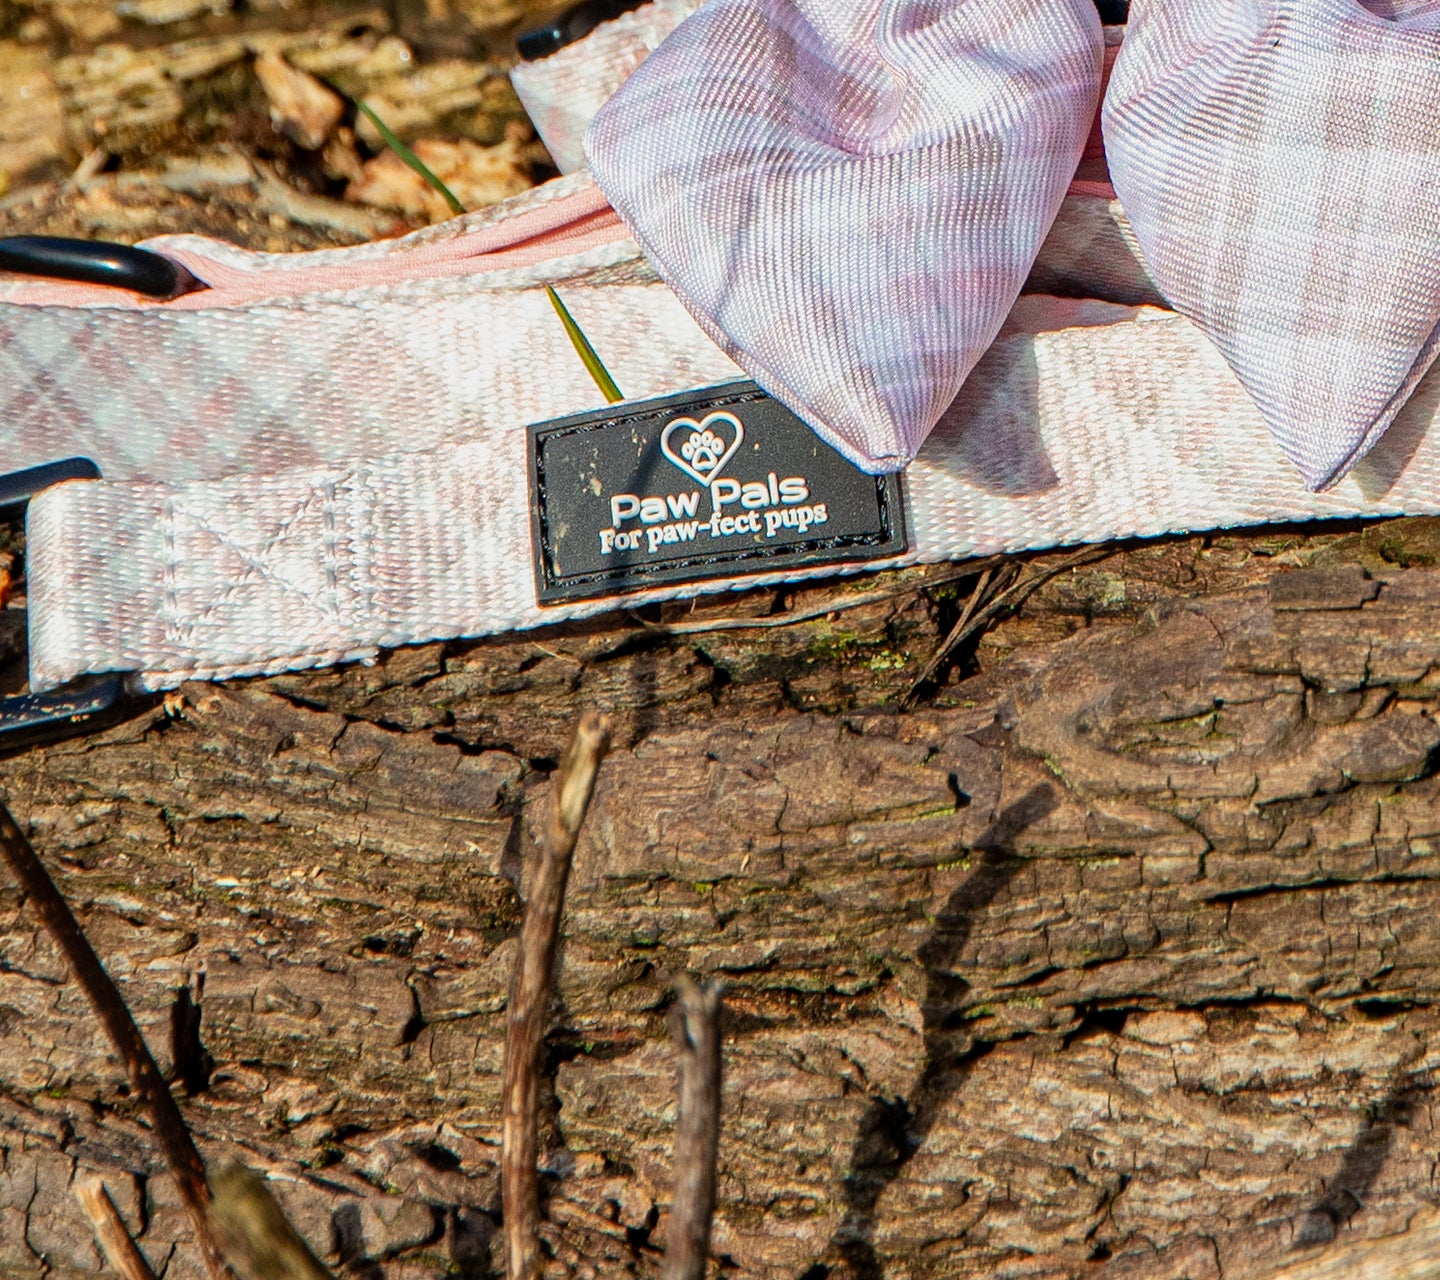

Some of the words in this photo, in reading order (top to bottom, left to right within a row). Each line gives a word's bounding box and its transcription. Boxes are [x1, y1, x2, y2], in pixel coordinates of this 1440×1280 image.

[611, 491, 700, 527] Paw
[710, 472, 810, 513] Pals
[599, 528, 642, 555] For
[647, 508, 761, 553] paw-fect
[764, 503, 828, 540] pups
